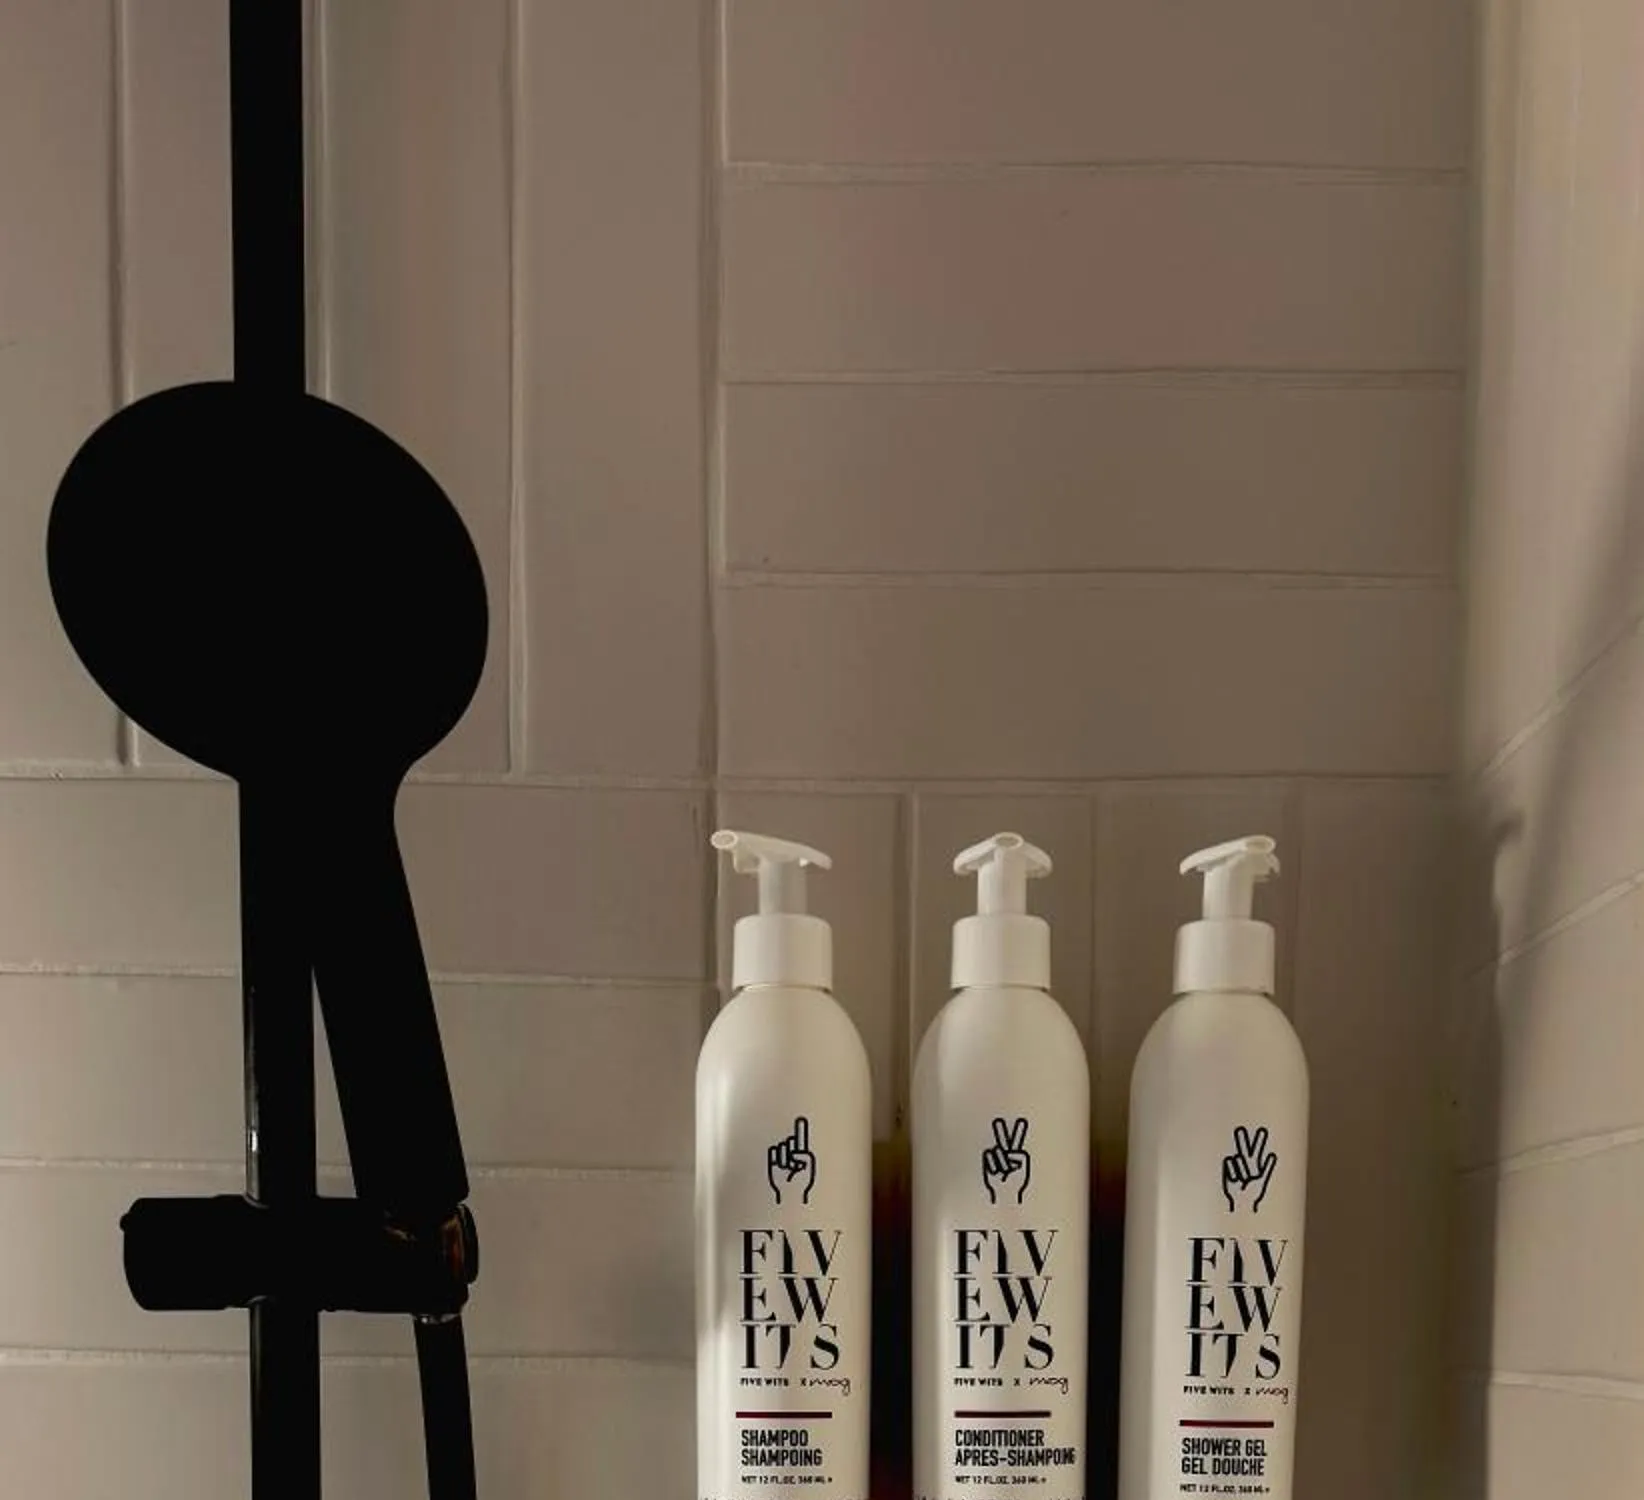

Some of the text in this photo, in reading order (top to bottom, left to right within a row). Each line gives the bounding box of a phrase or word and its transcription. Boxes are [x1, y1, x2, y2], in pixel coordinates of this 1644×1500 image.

[740, 1377, 761, 1387] FIVE
[954, 1377, 975, 1387] FIVE
[1183, 1385, 1206, 1395] FIVE
[741, 1429, 809, 1447] SHAMPOO
[955, 1429, 1045, 1447] CONDITIONER
[1181, 1438, 1267, 1457] SHOWER GEL
[741, 1449, 823, 1467] SHAMPOING
[1181, 1457, 1265, 1476] GEL DOUCHE
